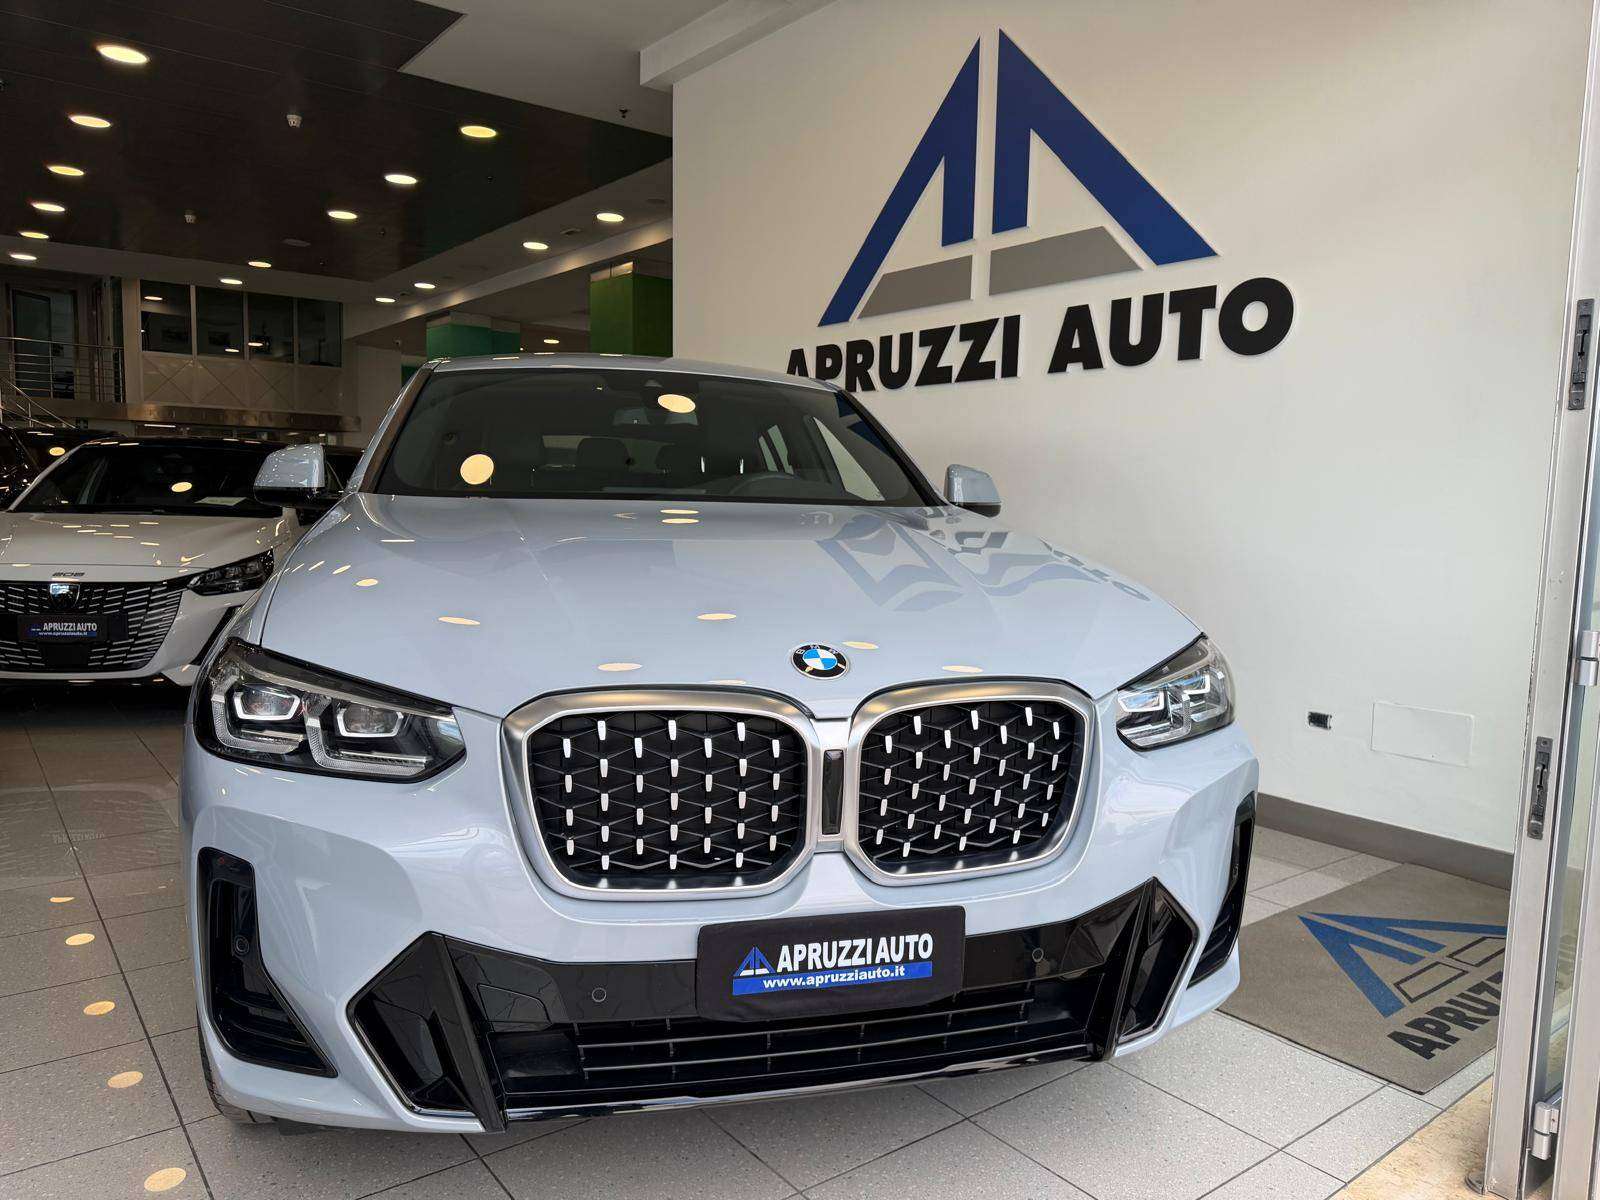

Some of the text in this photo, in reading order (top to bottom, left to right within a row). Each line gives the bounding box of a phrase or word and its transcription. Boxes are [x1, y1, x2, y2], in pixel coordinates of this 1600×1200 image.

[787, 277, 1295, 393] APRUZZI AUTO
[43, 622, 98, 631] APRUZZI AUTO
[776, 933, 934, 973] APRUZZI AUTO
[763, 965, 905, 988] www.apruzziauto.it
